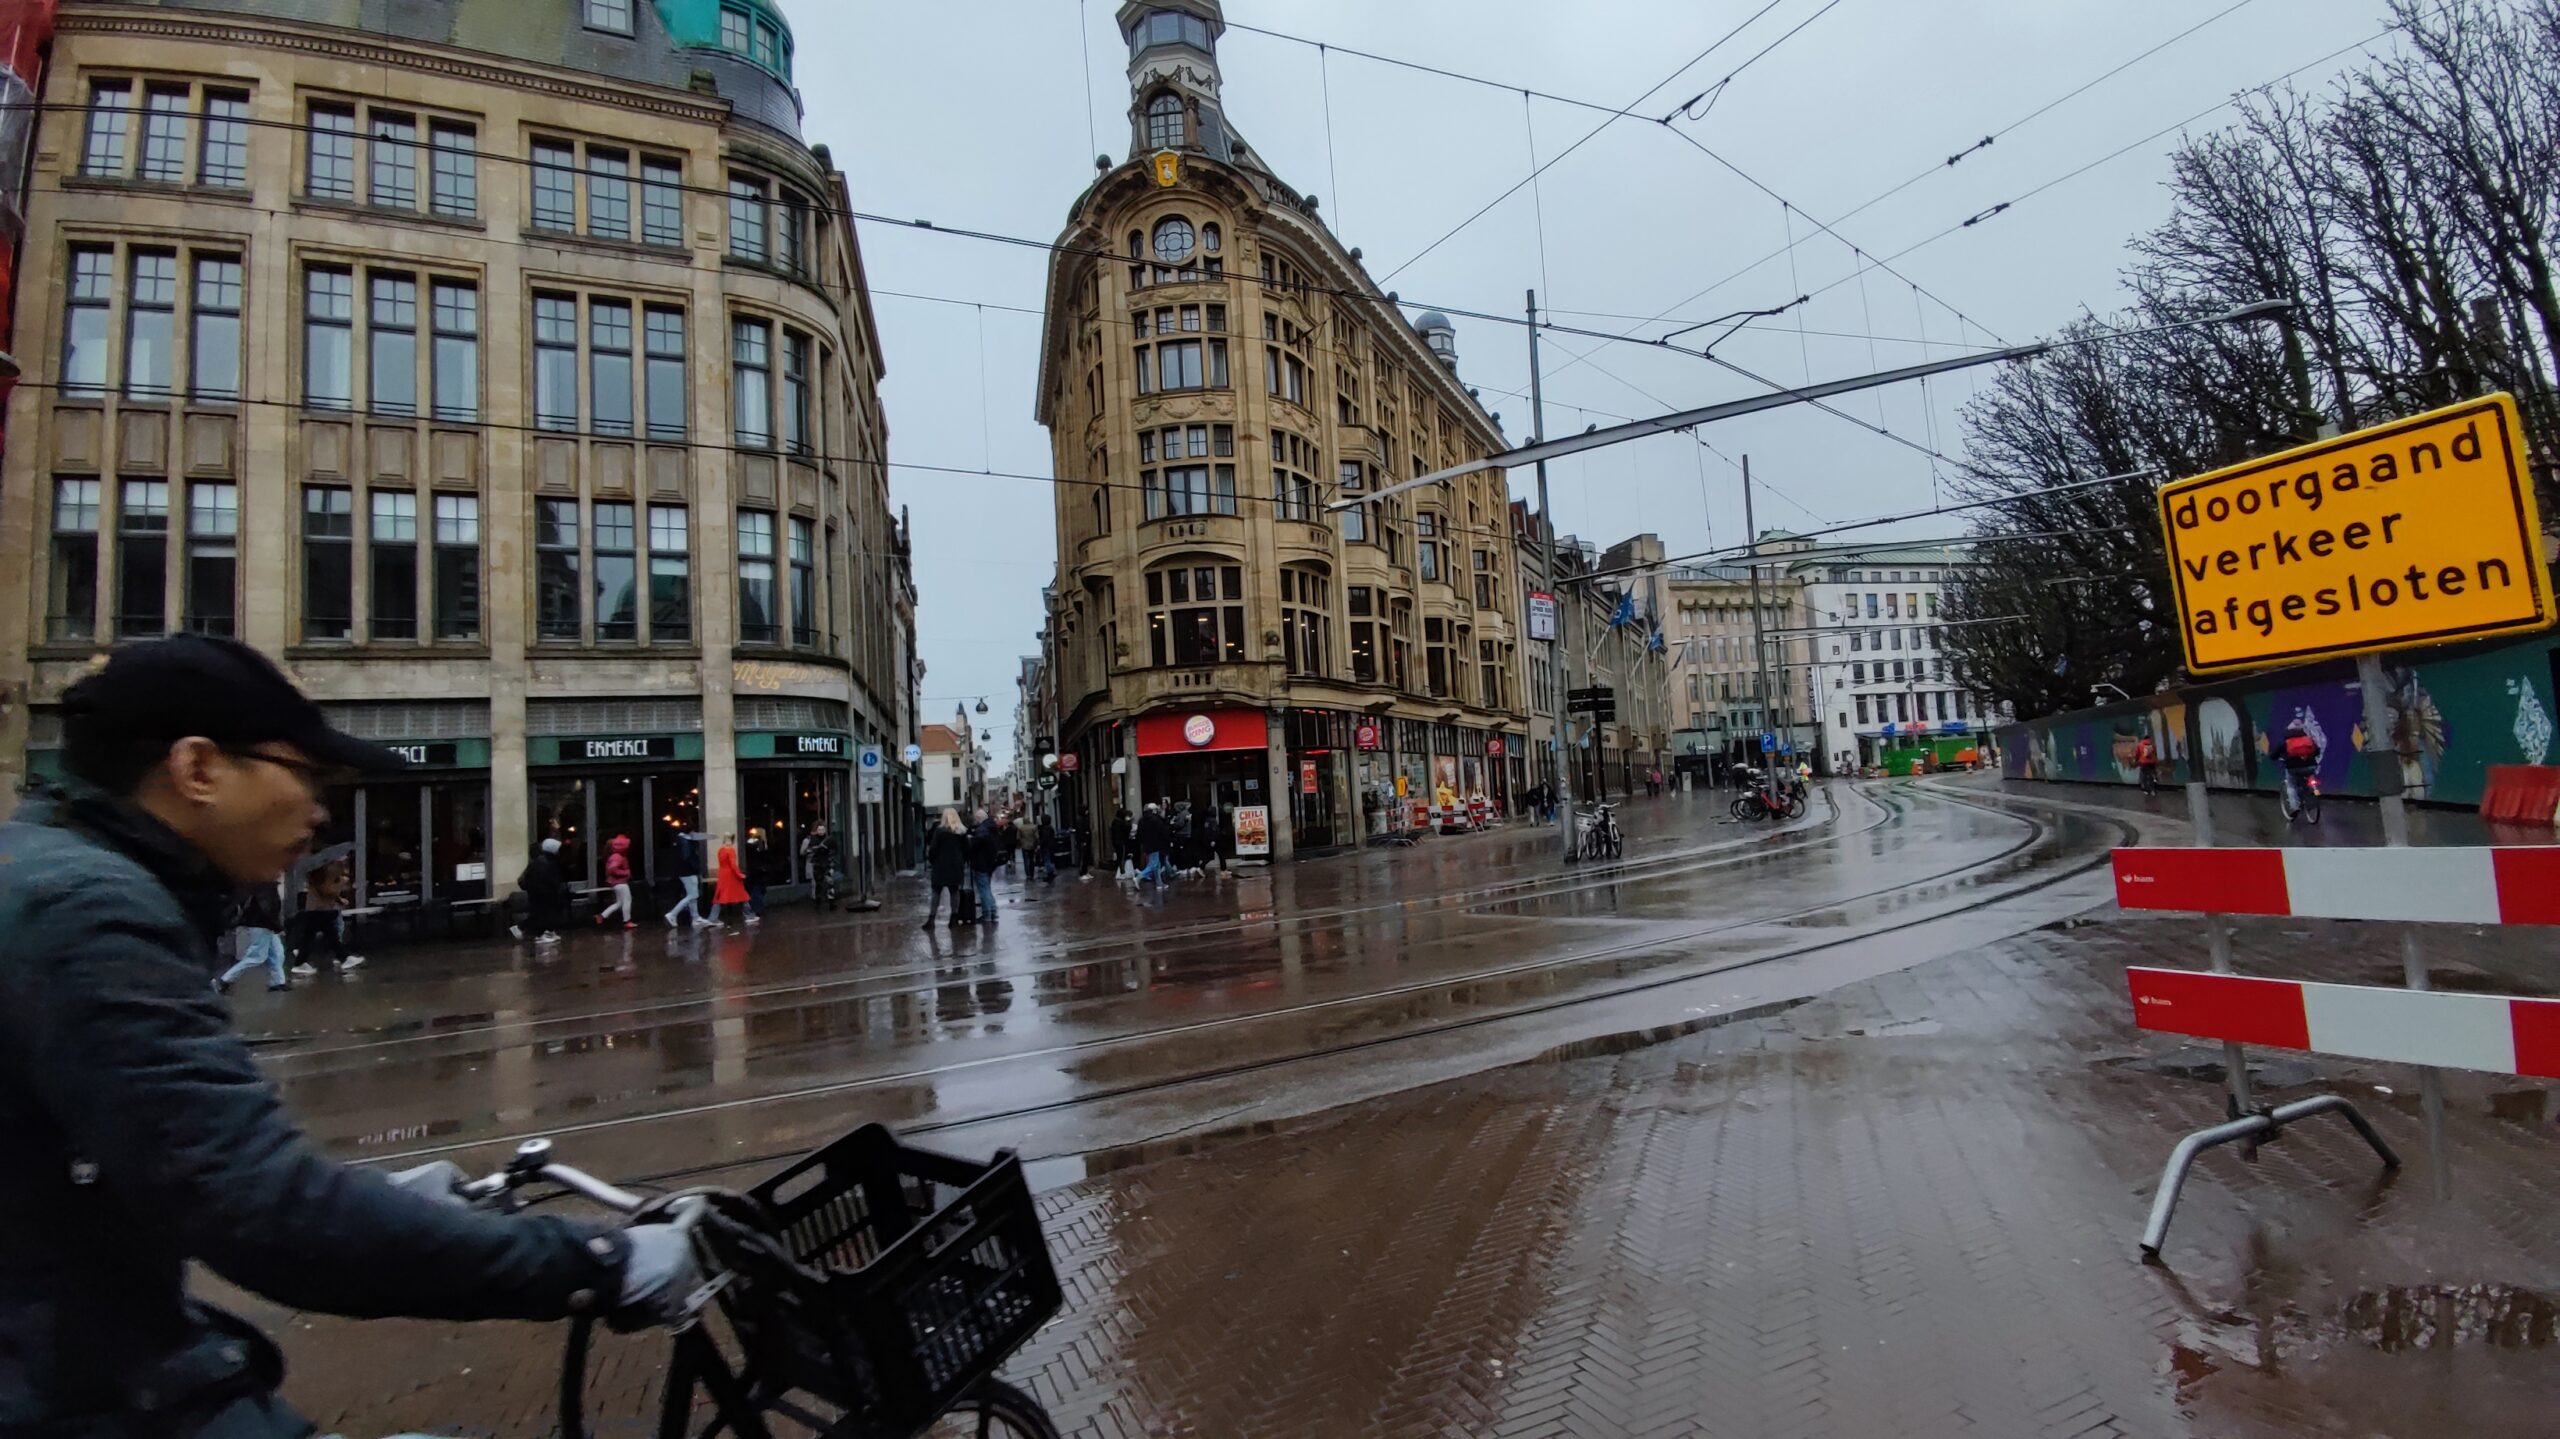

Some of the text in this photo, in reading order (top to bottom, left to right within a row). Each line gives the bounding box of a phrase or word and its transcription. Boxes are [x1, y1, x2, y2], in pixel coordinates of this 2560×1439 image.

[2175, 421, 2483, 529] doorgaand
[2184, 512, 2402, 582] verkeer
[2194, 556, 2511, 637] afgesloten
[1189, 725, 1211, 737] KING
[586, 740, 649, 757] EKMEKCI
[798, 736, 838, 753] EKMEKCI
[1239, 810, 1263, 821] CHILI
[2133, 873, 2155, 883] bam
